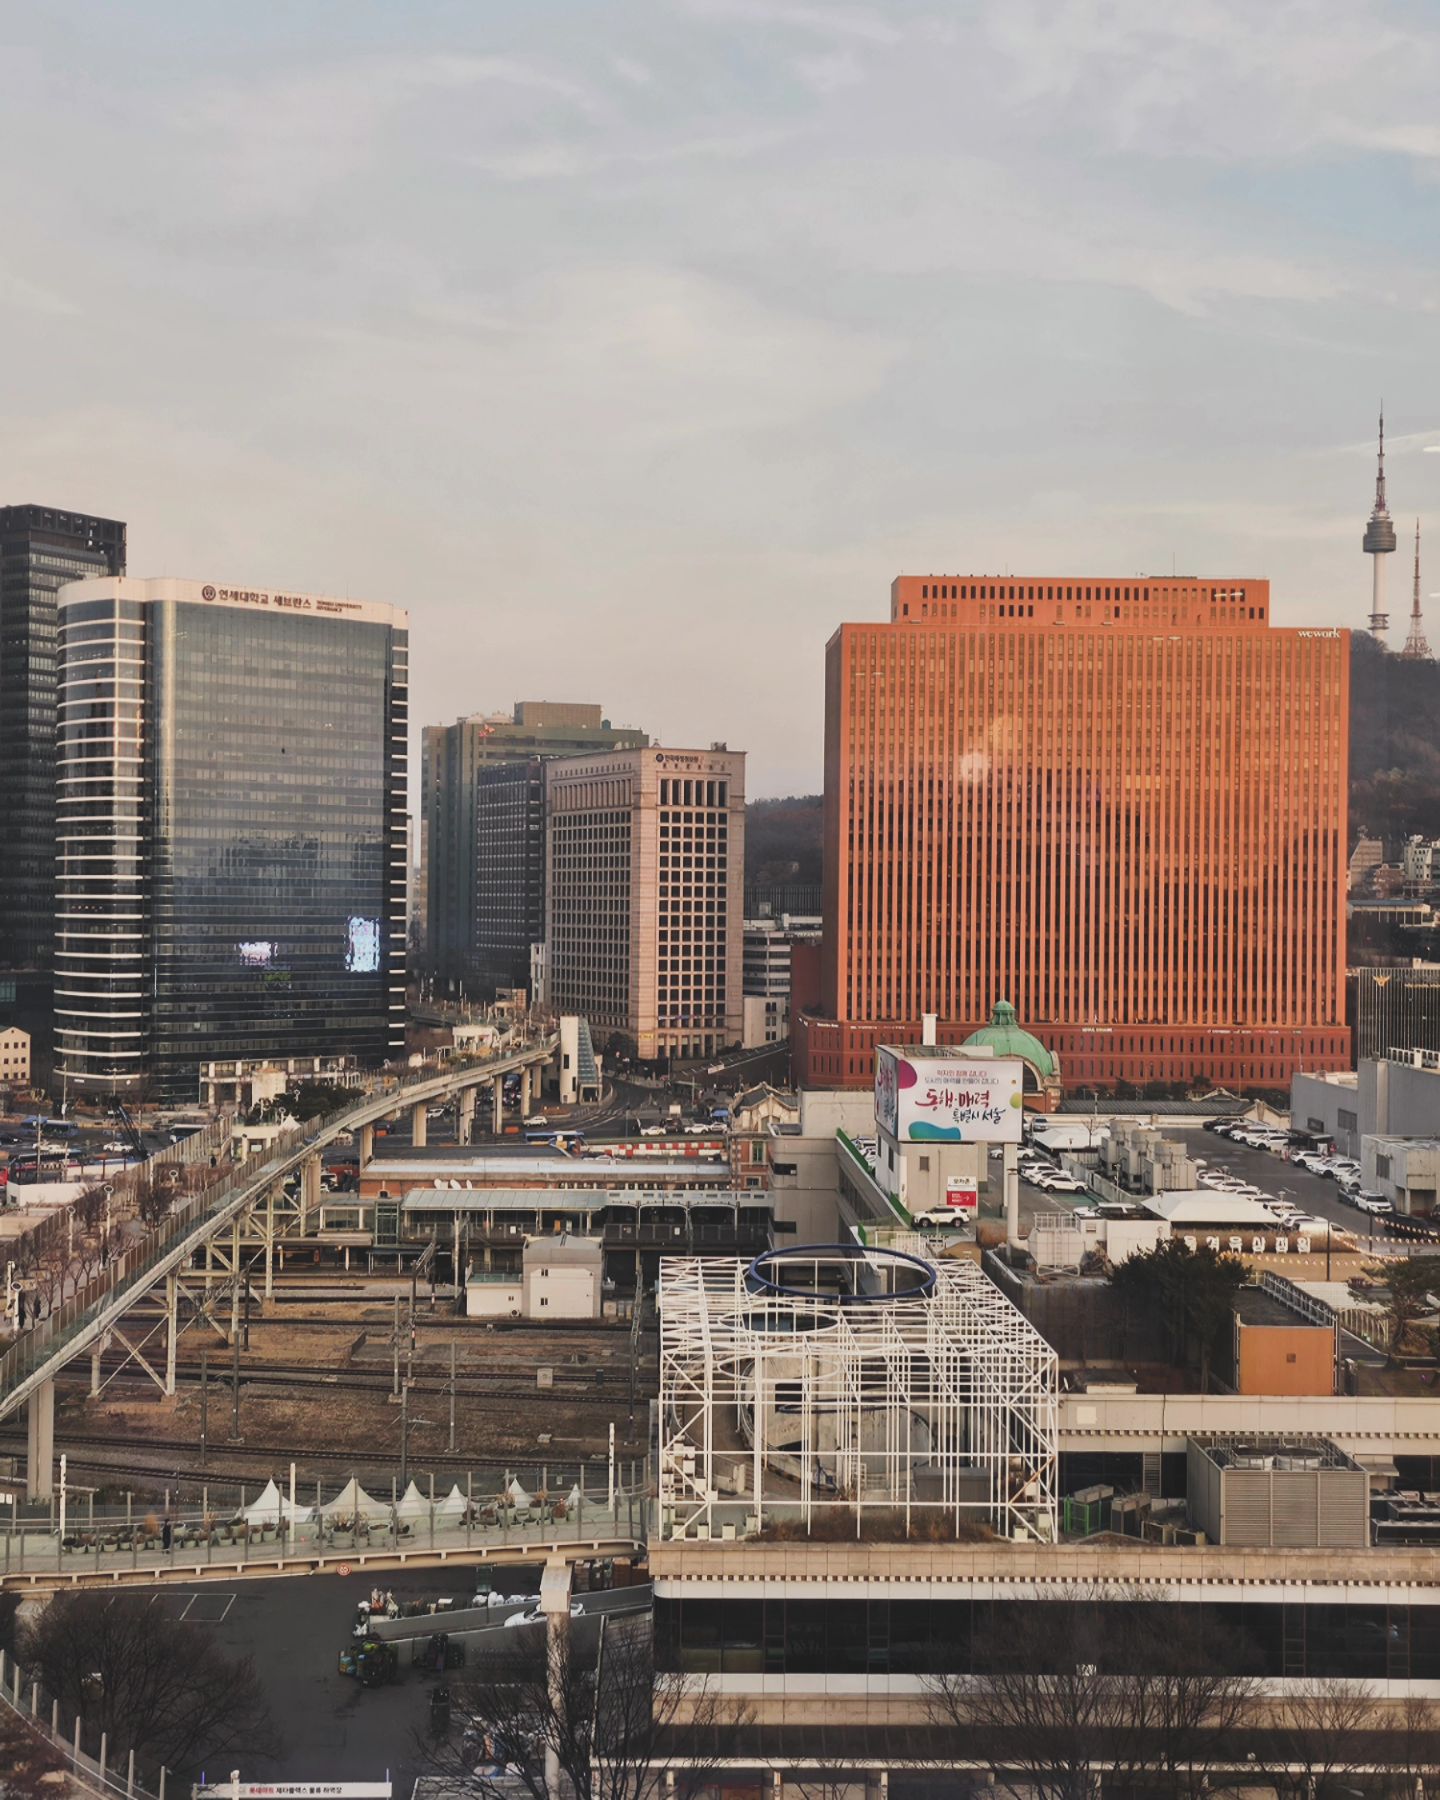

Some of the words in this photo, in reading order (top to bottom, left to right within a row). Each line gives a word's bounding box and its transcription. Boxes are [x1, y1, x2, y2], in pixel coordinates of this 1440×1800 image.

[218, 589, 269, 605] 연세대학교
[273, 594, 312, 610] 세브란스
[1298, 627, 1341, 639] wework
[952, 1108, 980, 1123] 특별시
[981, 1107, 1006, 1125] 서울
